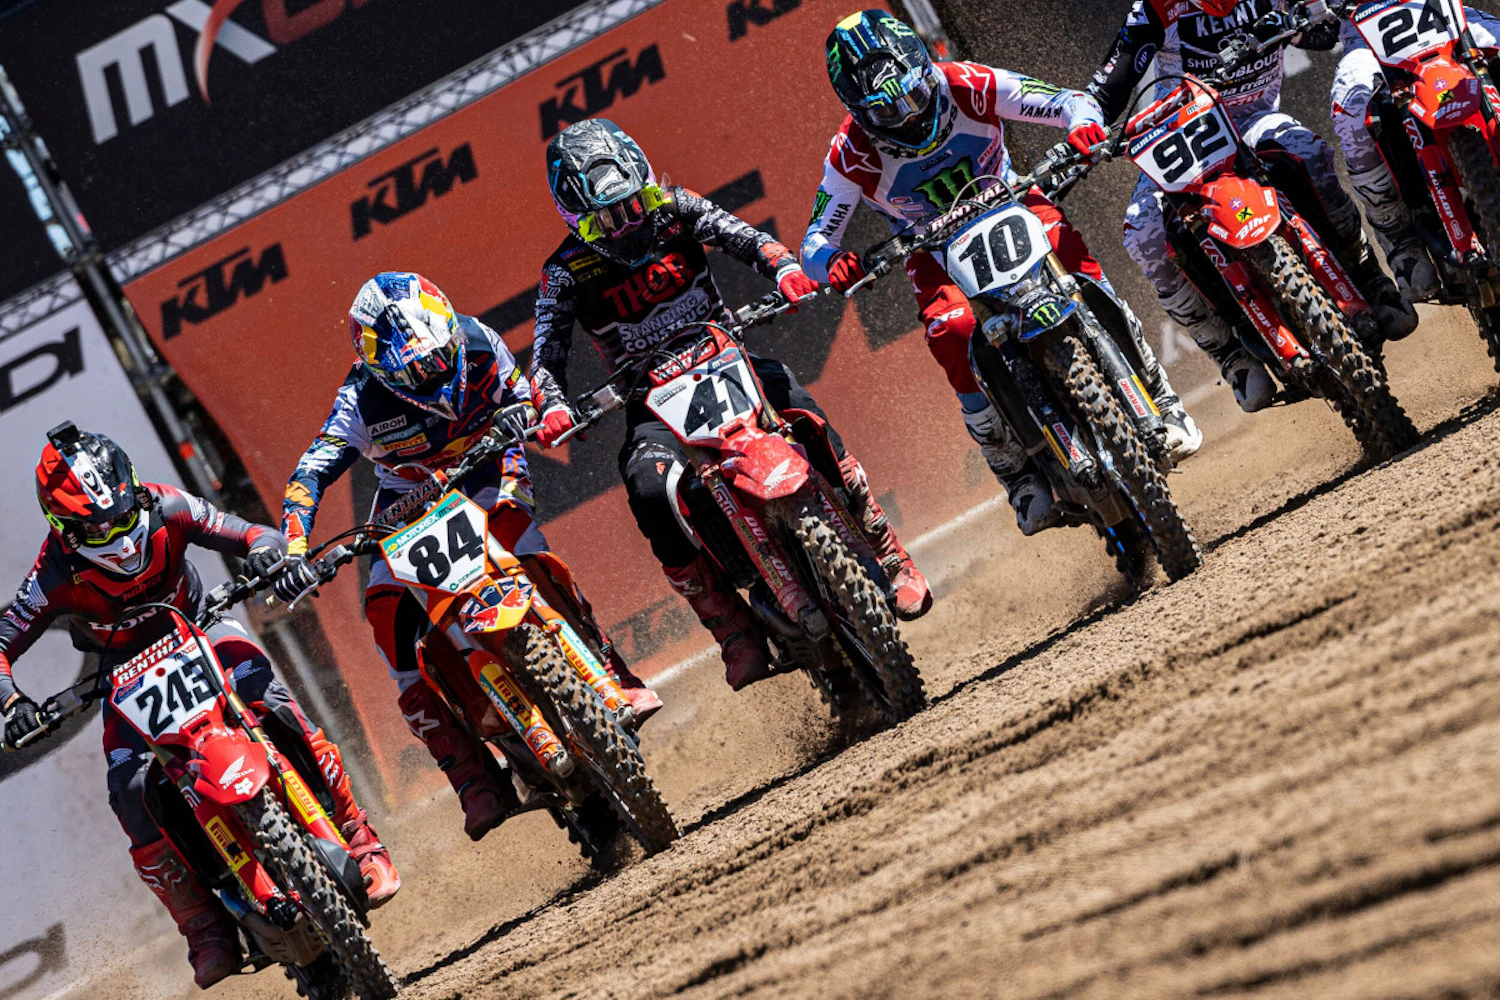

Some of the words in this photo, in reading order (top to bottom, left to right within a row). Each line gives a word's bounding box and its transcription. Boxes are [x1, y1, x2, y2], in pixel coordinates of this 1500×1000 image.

[1187, 56, 1218, 69] SHIP
[538, 42, 667, 141] KTM
[1152, 112, 1230, 184] 92
[350, 142, 479, 241] KTM
[1428, 168, 1455, 219] DUNLOP
[958, 213, 1032, 292] 10
[159, 243, 290, 341] KTM
[602, 251, 695, 319] THOR
[617, 288, 705, 341] STANDING
[624, 297, 714, 353] CONSTRUCT
[683, 363, 751, 437] 41
[1118, 379, 1147, 417] BRAKING
[370, 416, 407, 435] AIROH
[1053, 422, 1082, 461] BRAKING
[396, 510, 439, 546] MOTOREX
[408, 509, 484, 588] 84
[135, 656, 221, 739] 243
[182, 711, 208, 730] HONDA
[489, 690, 523, 732] MOTOREX
[286, 773, 318, 817] PIRELLI
